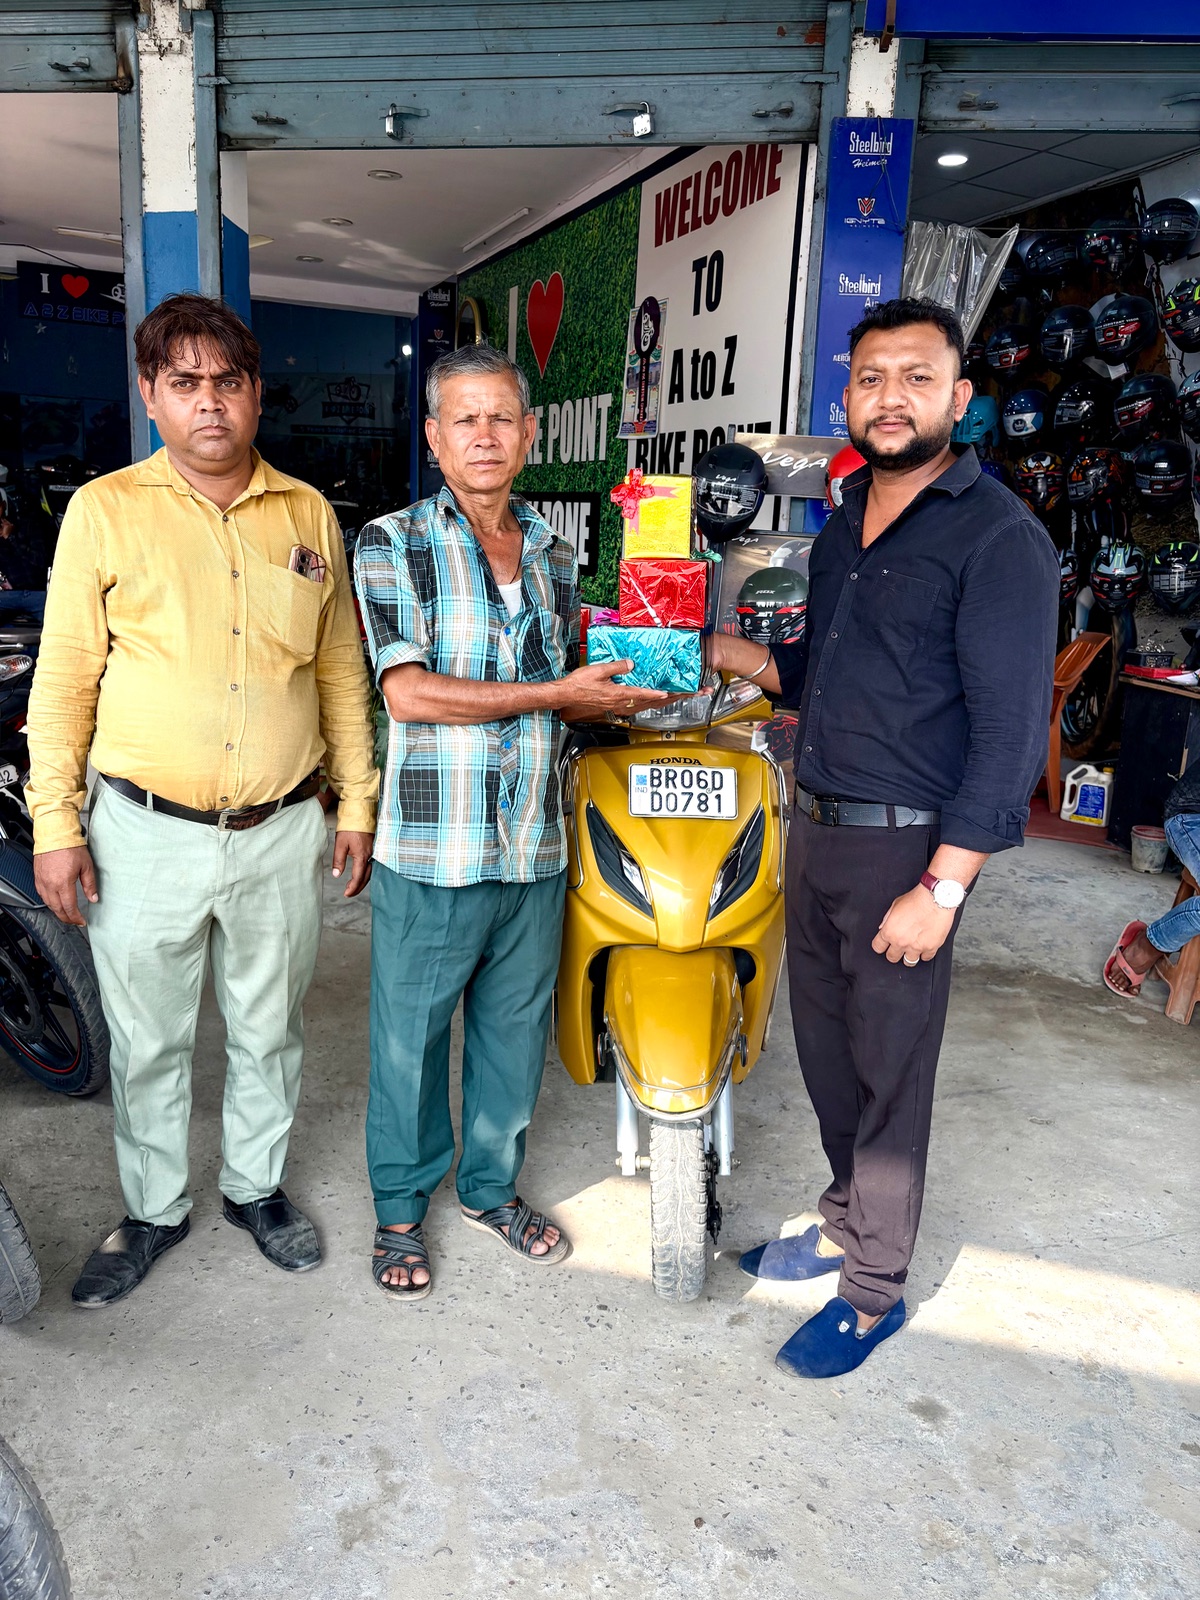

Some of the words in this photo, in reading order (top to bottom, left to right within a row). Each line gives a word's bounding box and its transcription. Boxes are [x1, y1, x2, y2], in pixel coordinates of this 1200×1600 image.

[849, 131, 893, 155] Steelbird
[654, 144, 783, 248] WELCOME
[40, 272, 50, 293] I
[691, 249, 724, 317] TO
[838, 273, 881, 296] Steelbird
[23, 302, 39, 317] A
[57, 304, 69, 320] Z
[72, 306, 109, 324] BIKE
[667, 348, 684, 406] A
[690, 348, 716, 401] to
[722, 334, 738, 397] Z
[547, 392, 613, 465] POINT
[635, 431, 687, 475] BIKE
[650, 757, 703, 766] HONDA
[649, 767, 724, 791] BR06D
[650, 791, 722, 814] D0781
